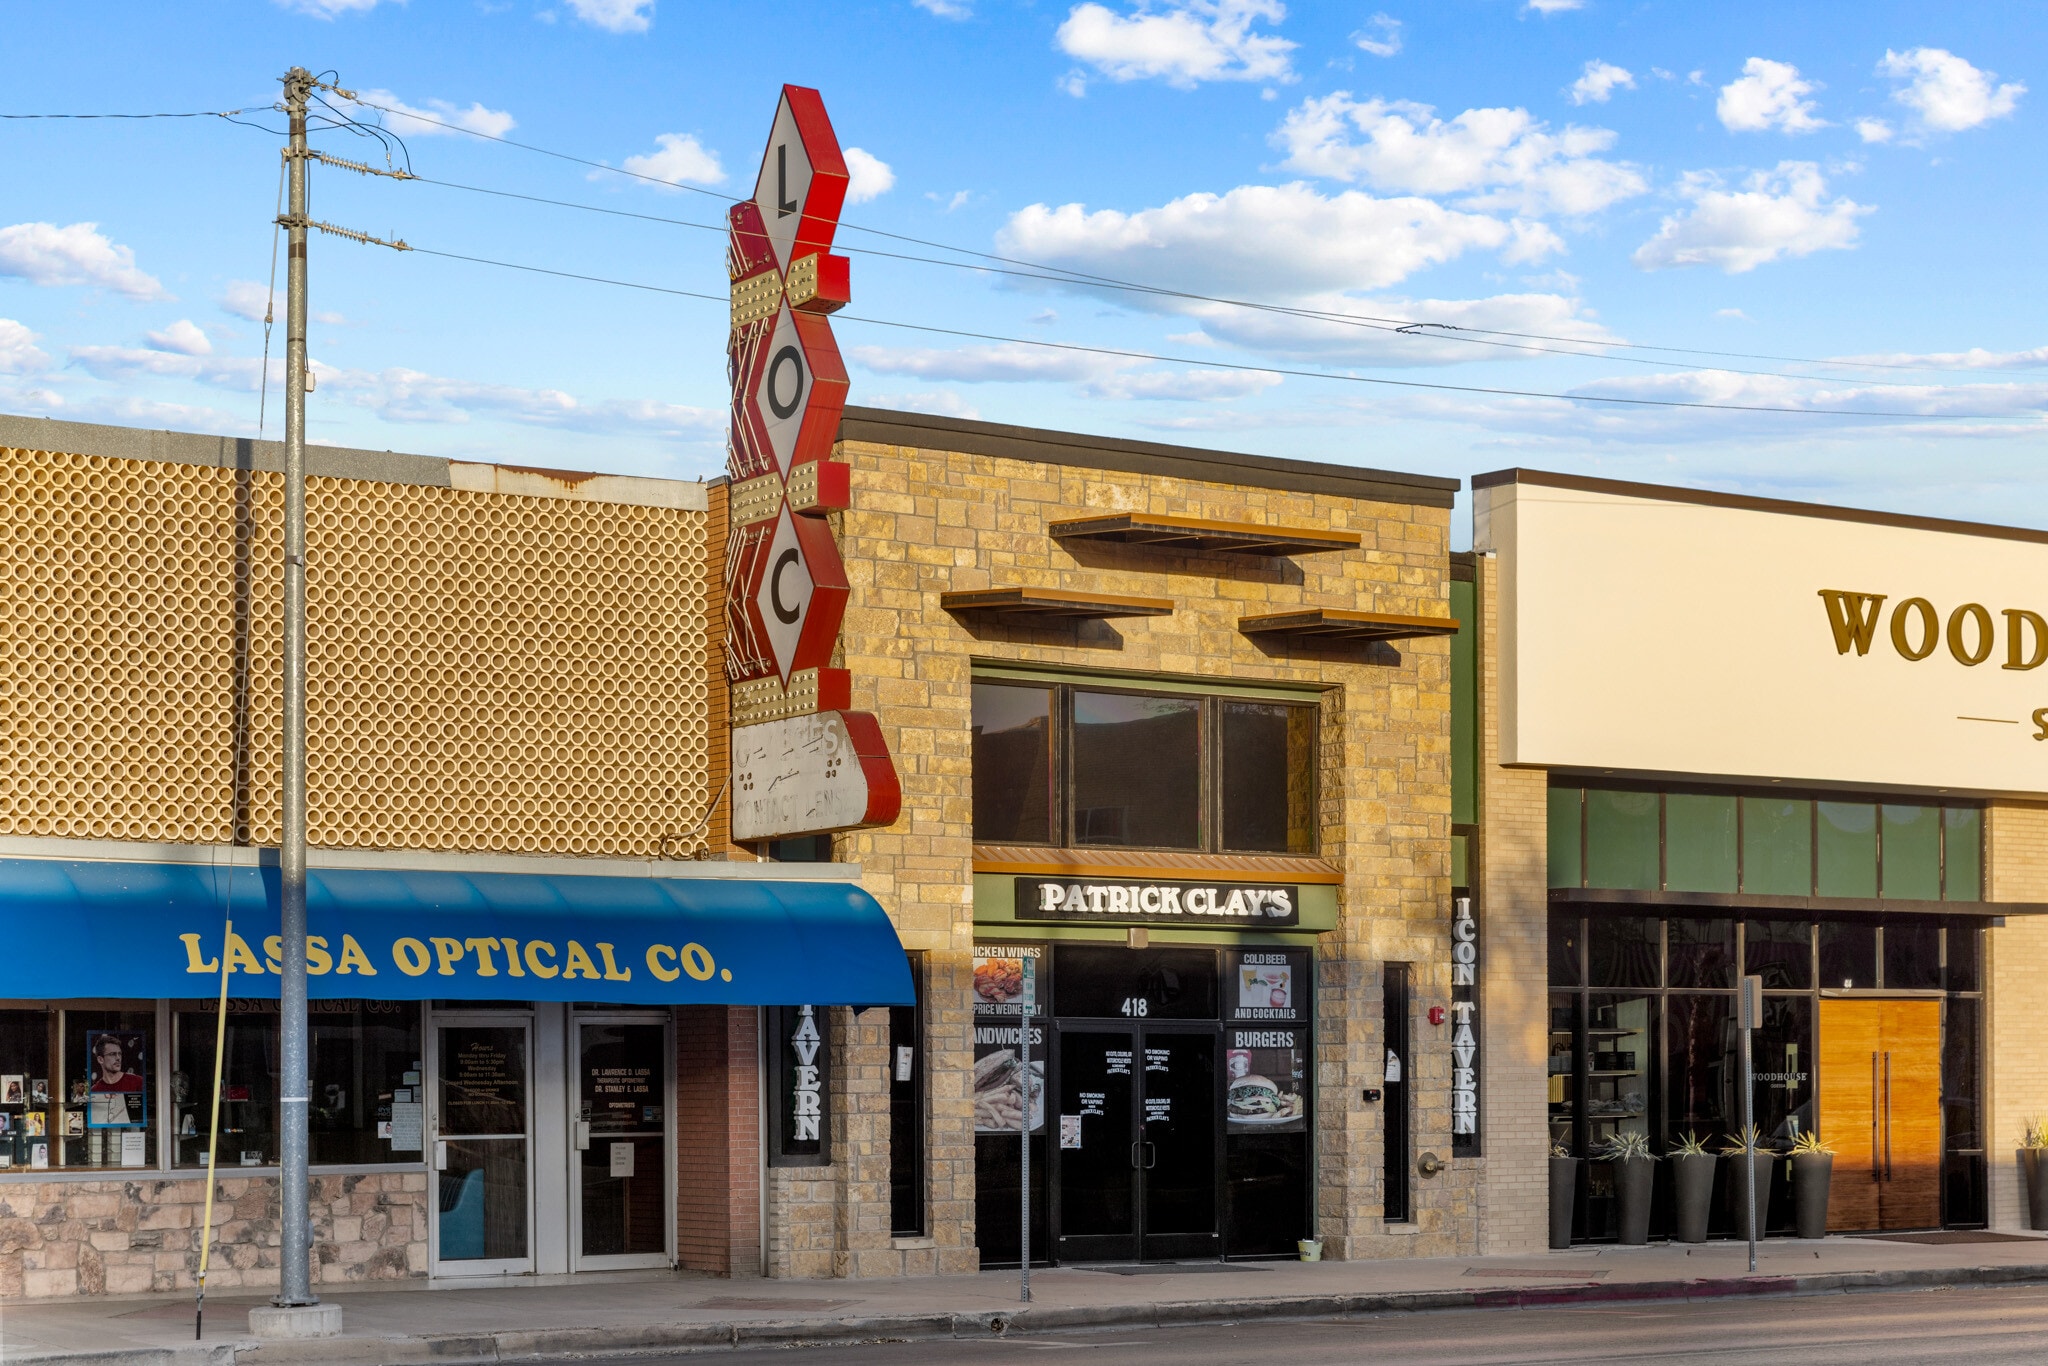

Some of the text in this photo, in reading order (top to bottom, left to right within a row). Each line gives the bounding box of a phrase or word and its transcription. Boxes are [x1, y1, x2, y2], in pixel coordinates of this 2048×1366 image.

[1817, 589, 2048, 671] WOOD
[1038, 883, 1292, 918] PATRICK CLAY'S
[1451, 897, 1476, 986] ICON
[392, 937, 631, 982] OPTICAL
[645, 941, 732, 983] CO.
[1006, 947, 1041, 958] WINGS
[1244, 954, 1286, 964] COLD BEER
[974, 1003, 1041, 1015] PRICE WEDNEAY
[1121, 997, 1147, 1017] 418
[1234, 1008, 1296, 1019] AND COCKTAILS
[1235, 1031, 1294, 1048] BURGERS
[591, 1068, 600, 1076] DR.
[1451, 1001, 1476, 1134] TAVERN
[595, 1085, 603, 1093] DR.
[605, 1085, 625, 1093] STANLEY
